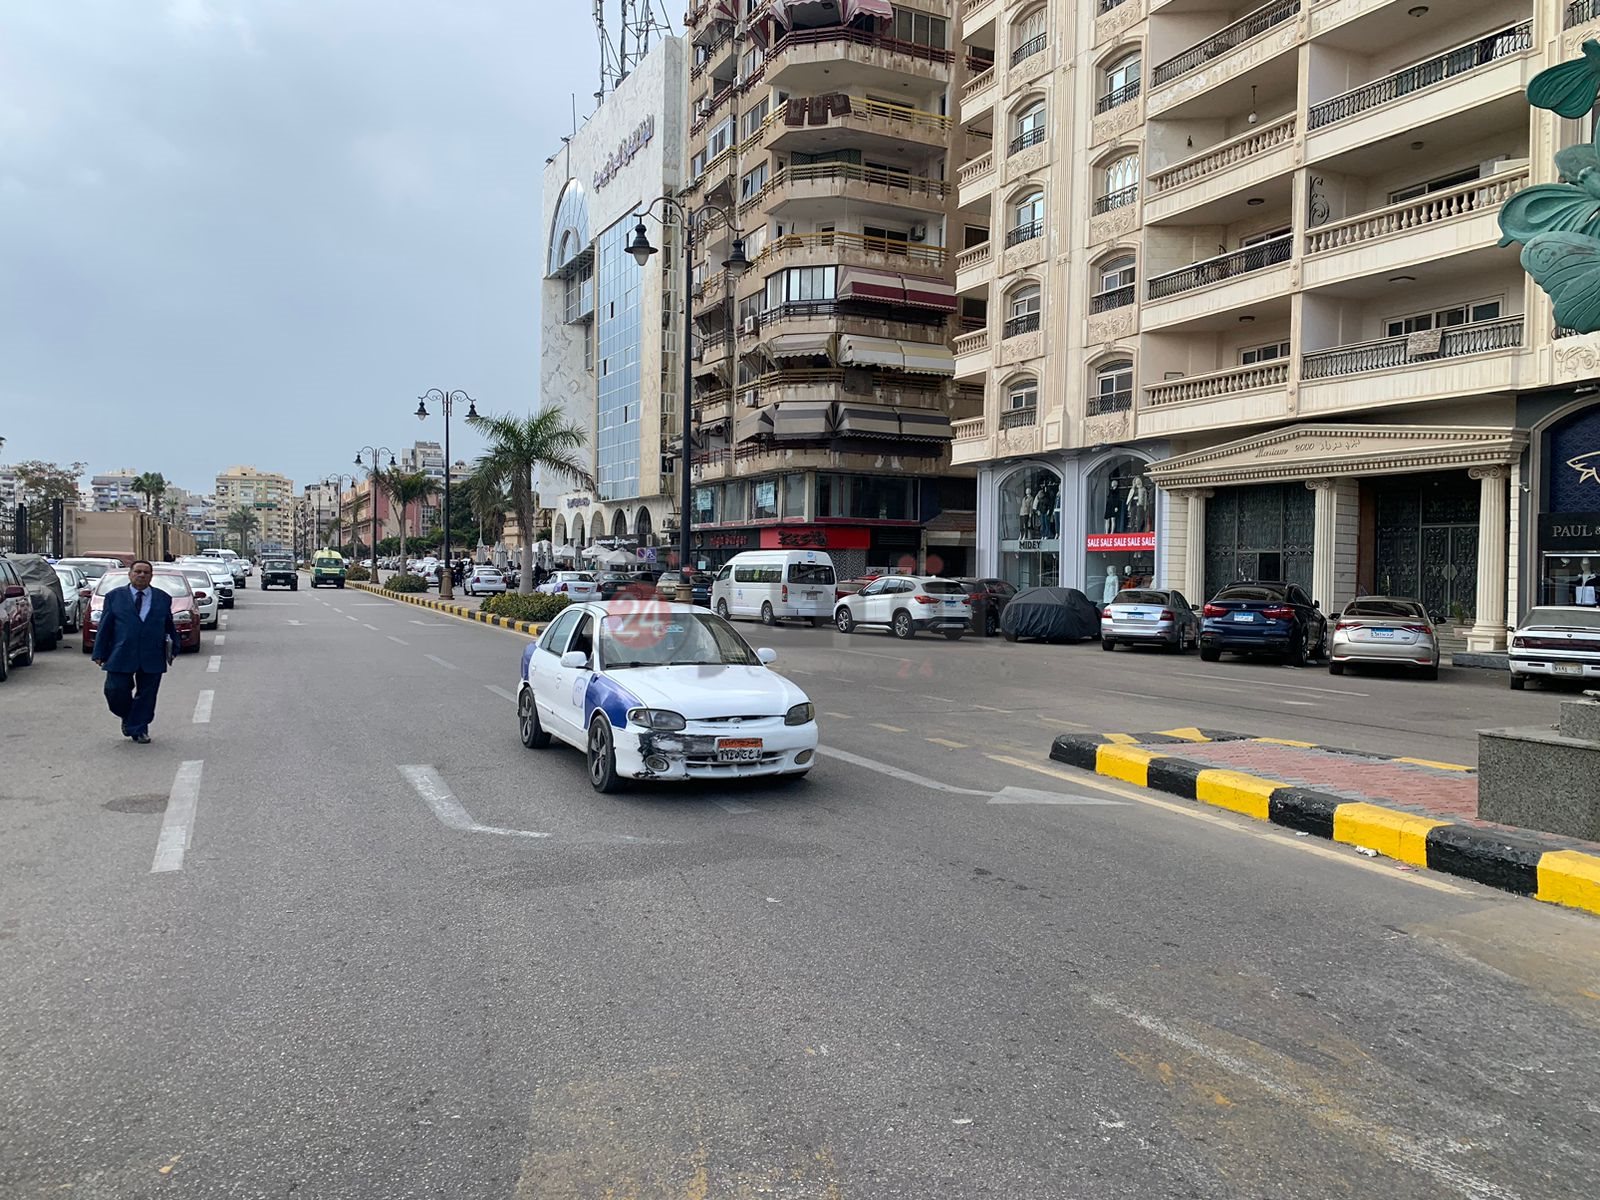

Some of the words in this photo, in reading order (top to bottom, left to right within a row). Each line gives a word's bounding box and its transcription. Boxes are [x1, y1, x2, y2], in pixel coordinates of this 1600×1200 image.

[1294, 443, 1315, 453] 2000
[1552, 525, 1592, 537] PAUL
[1019, 540, 1041, 550] MIDEY
[1087, 538, 1100, 547] SALE
[1100, 538, 1113, 547] SALE
[1113, 537, 1127, 547] SALE
[1127, 537, 1141, 546] SALE
[1141, 536, 1155, 546] SALE
